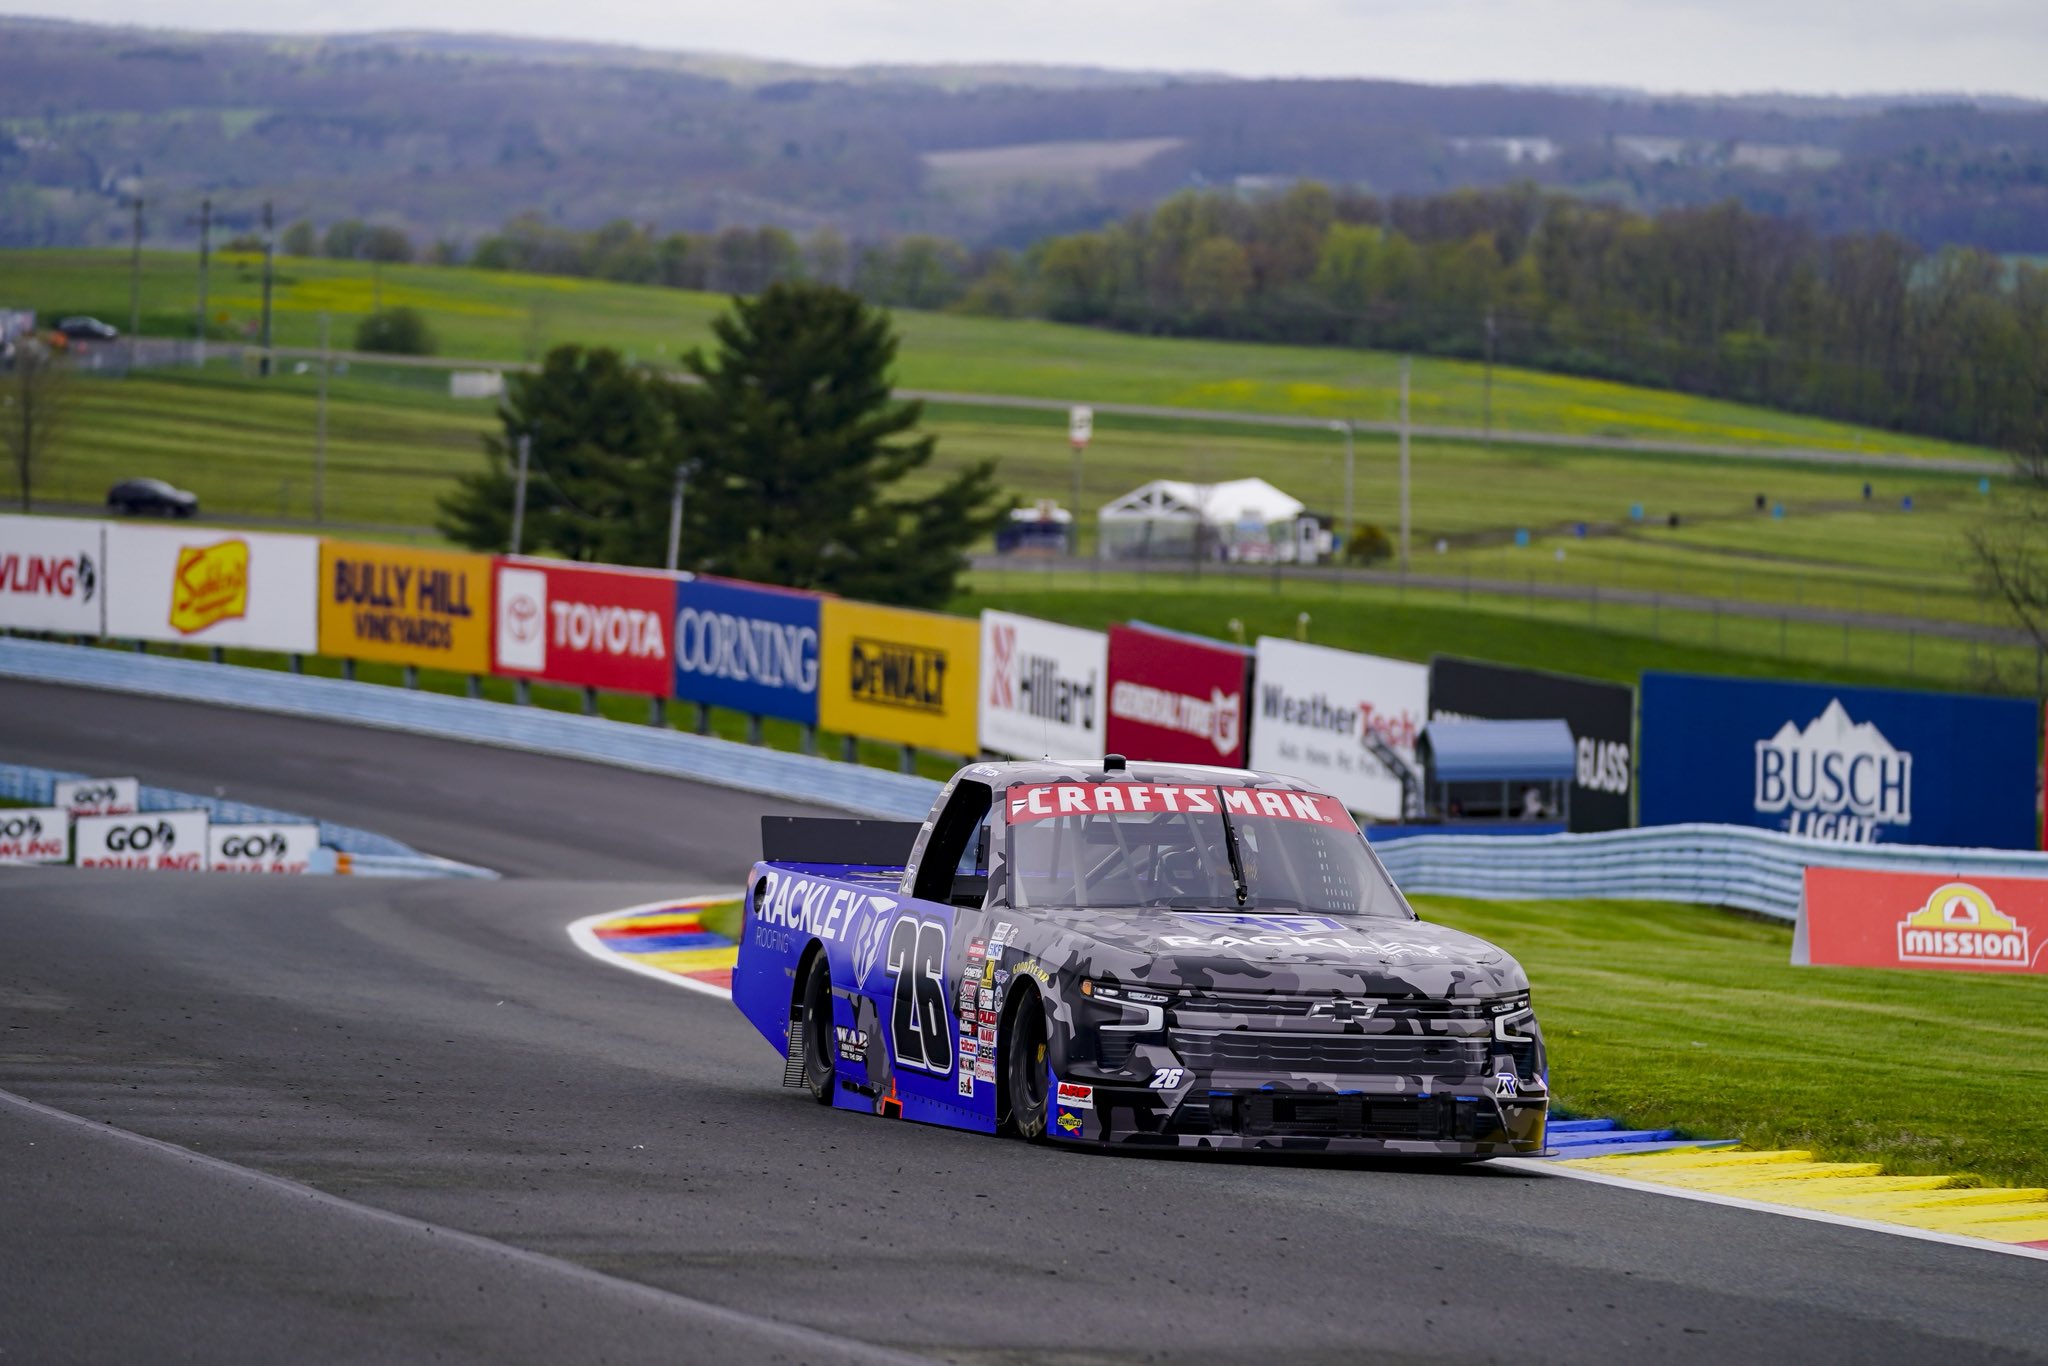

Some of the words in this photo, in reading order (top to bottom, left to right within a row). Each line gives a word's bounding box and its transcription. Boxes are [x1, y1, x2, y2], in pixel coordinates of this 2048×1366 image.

[335, 559, 412, 609] BULLY
[417, 567, 473, 618] HILL
[355, 612, 452, 650] VINEYARDS
[551, 600, 666, 659] TOYOTA
[676, 607, 819, 693] CORNING
[1019, 651, 1096, 731] Hilliard
[1577, 737, 1629, 794] GLASS
[1758, 743, 1909, 819] BUSCH
[1028, 786, 1324, 821] CRAFTSMAN
[107, 825, 153, 851] GO
[1790, 811, 1878, 844] LIGHT
[222, 835, 266, 858] GO
[758, 871, 867, 942] RACKLEY
[756, 926, 789, 953] ROOFING
[988, 943, 1003, 957] SKF
[1012, 958, 1049, 983] GOODYEAR
[886, 914, 953, 1075] 26
[1059, 1084, 1092, 1098] ARP
[1149, 1068, 1184, 1089] 26
[1058, 1116, 1083, 1128] SUNOCO
